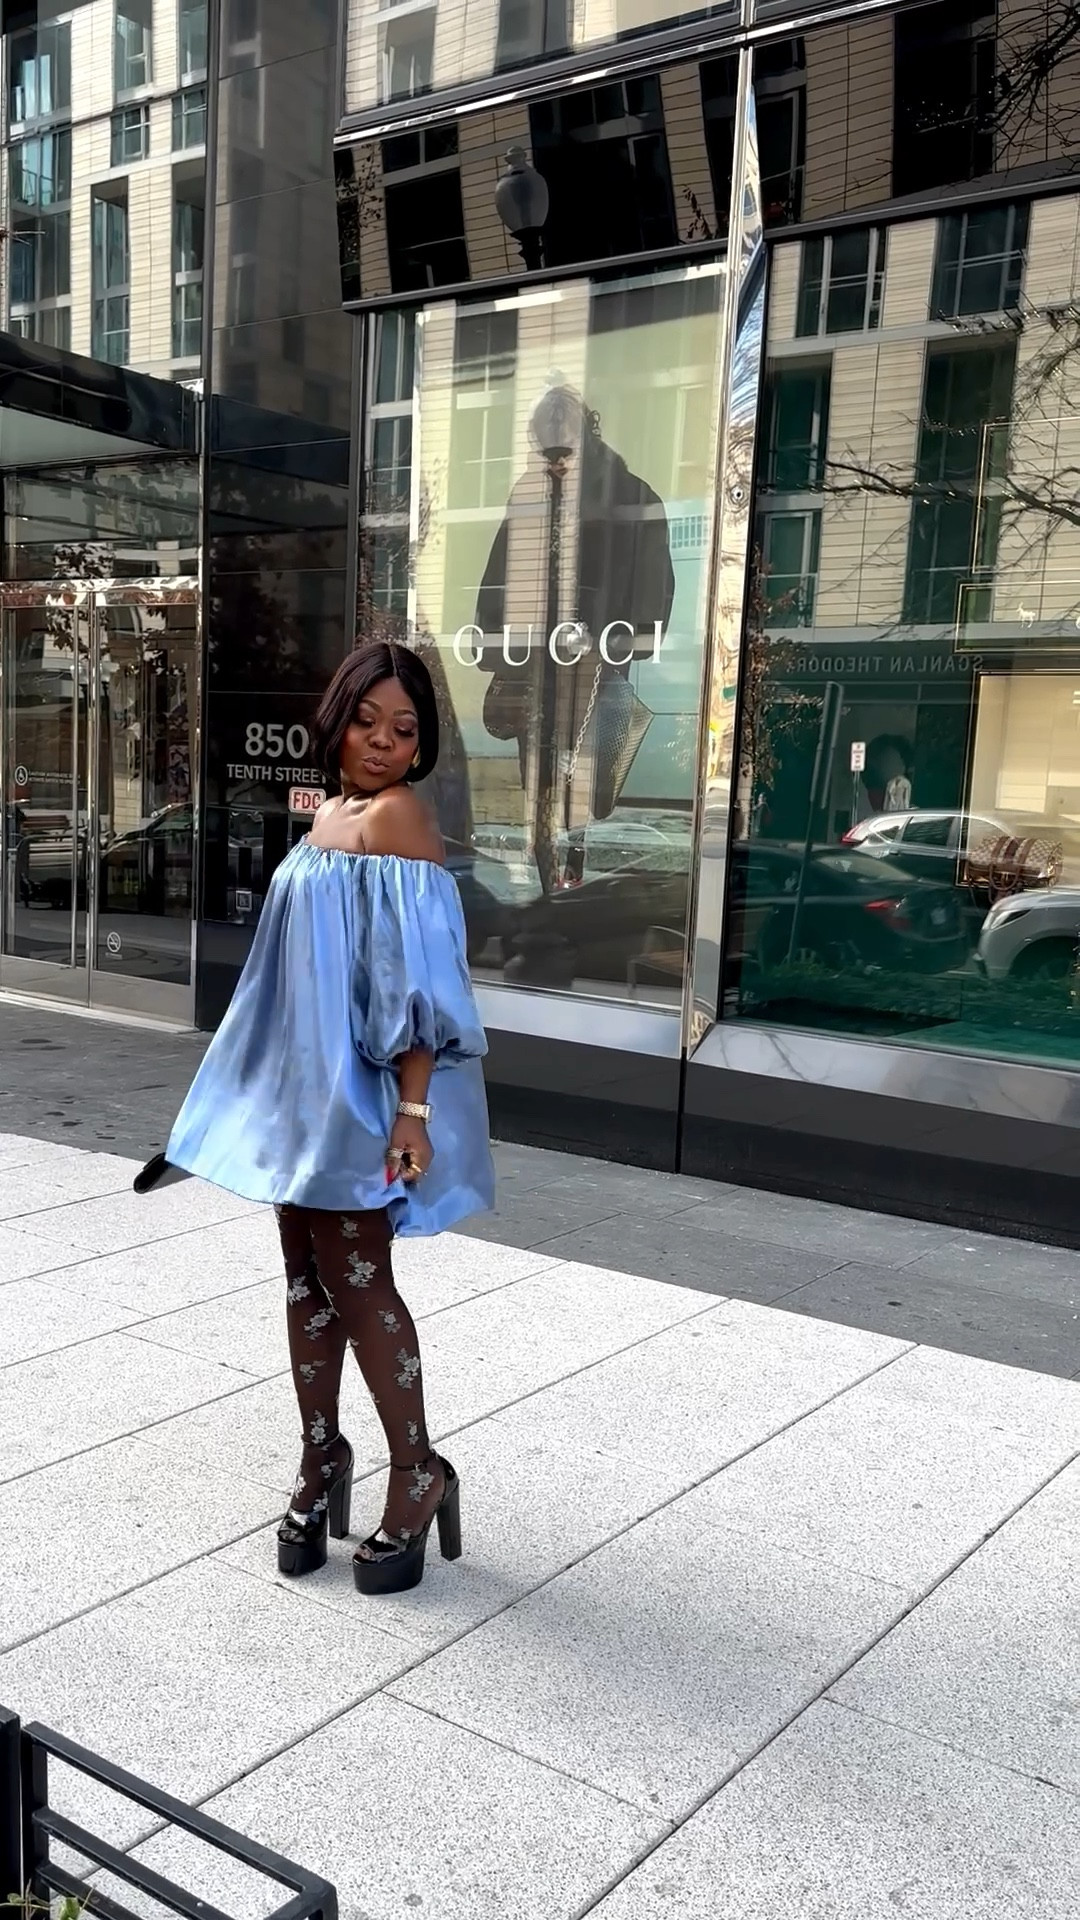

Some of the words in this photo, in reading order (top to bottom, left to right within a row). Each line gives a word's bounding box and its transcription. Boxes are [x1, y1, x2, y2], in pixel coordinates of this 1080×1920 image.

[452, 620, 663, 667] GUCCI
[245, 722, 310, 760] 850
[227, 763, 272, 781] TENTH
[293, 791, 321, 810] FDC
